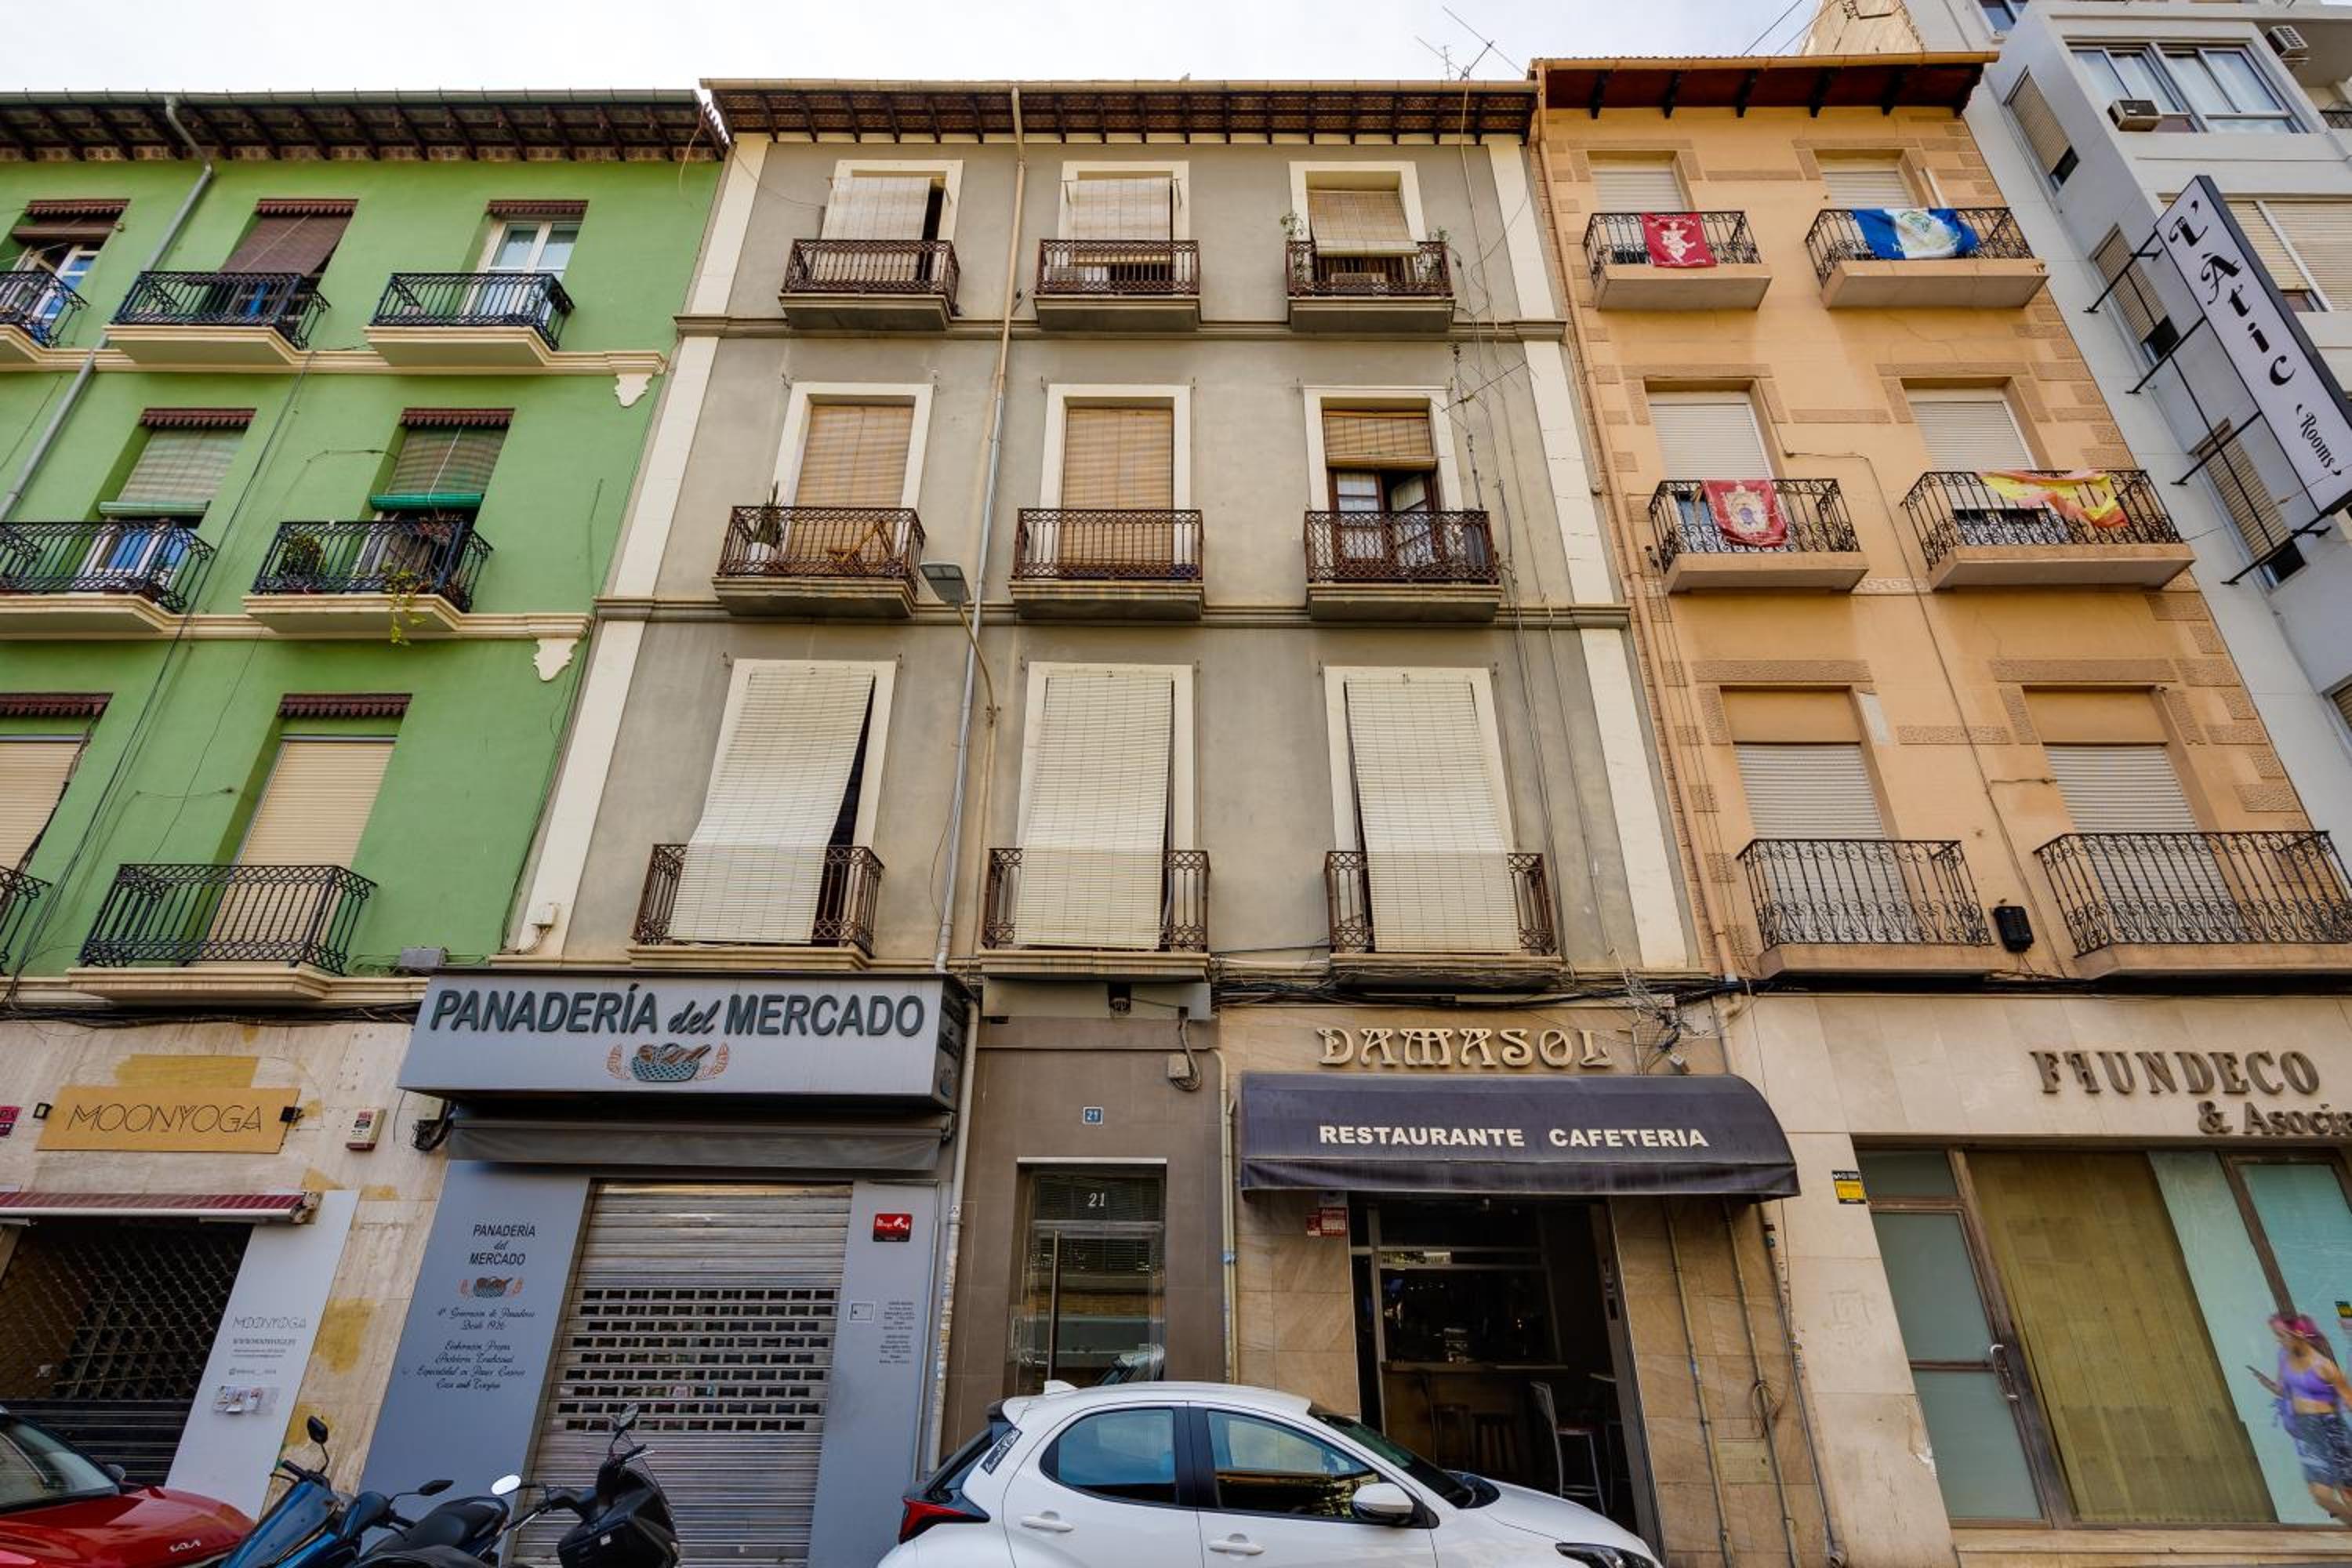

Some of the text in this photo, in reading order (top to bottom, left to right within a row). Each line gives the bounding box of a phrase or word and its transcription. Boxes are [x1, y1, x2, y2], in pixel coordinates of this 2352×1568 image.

[429, 983, 658, 1035] PANADERÍA
[667, 1000, 721, 1035] del
[724, 993, 925, 1037] MERCADO
[1316, 1027, 1614, 1068] DAMASOL
[66, 1103, 261, 1133] MOONYOGA
[1086, 1109, 1099, 1120] 21
[2196, 1099, 2234, 1135] &
[1319, 1126, 1710, 1148] RESTAURANTE CAFETERIA
[1087, 1192, 1105, 1207] 21
[473, 1223, 535, 1237] PANADERÍA
[470, 1252, 526, 1266] MERCADO
